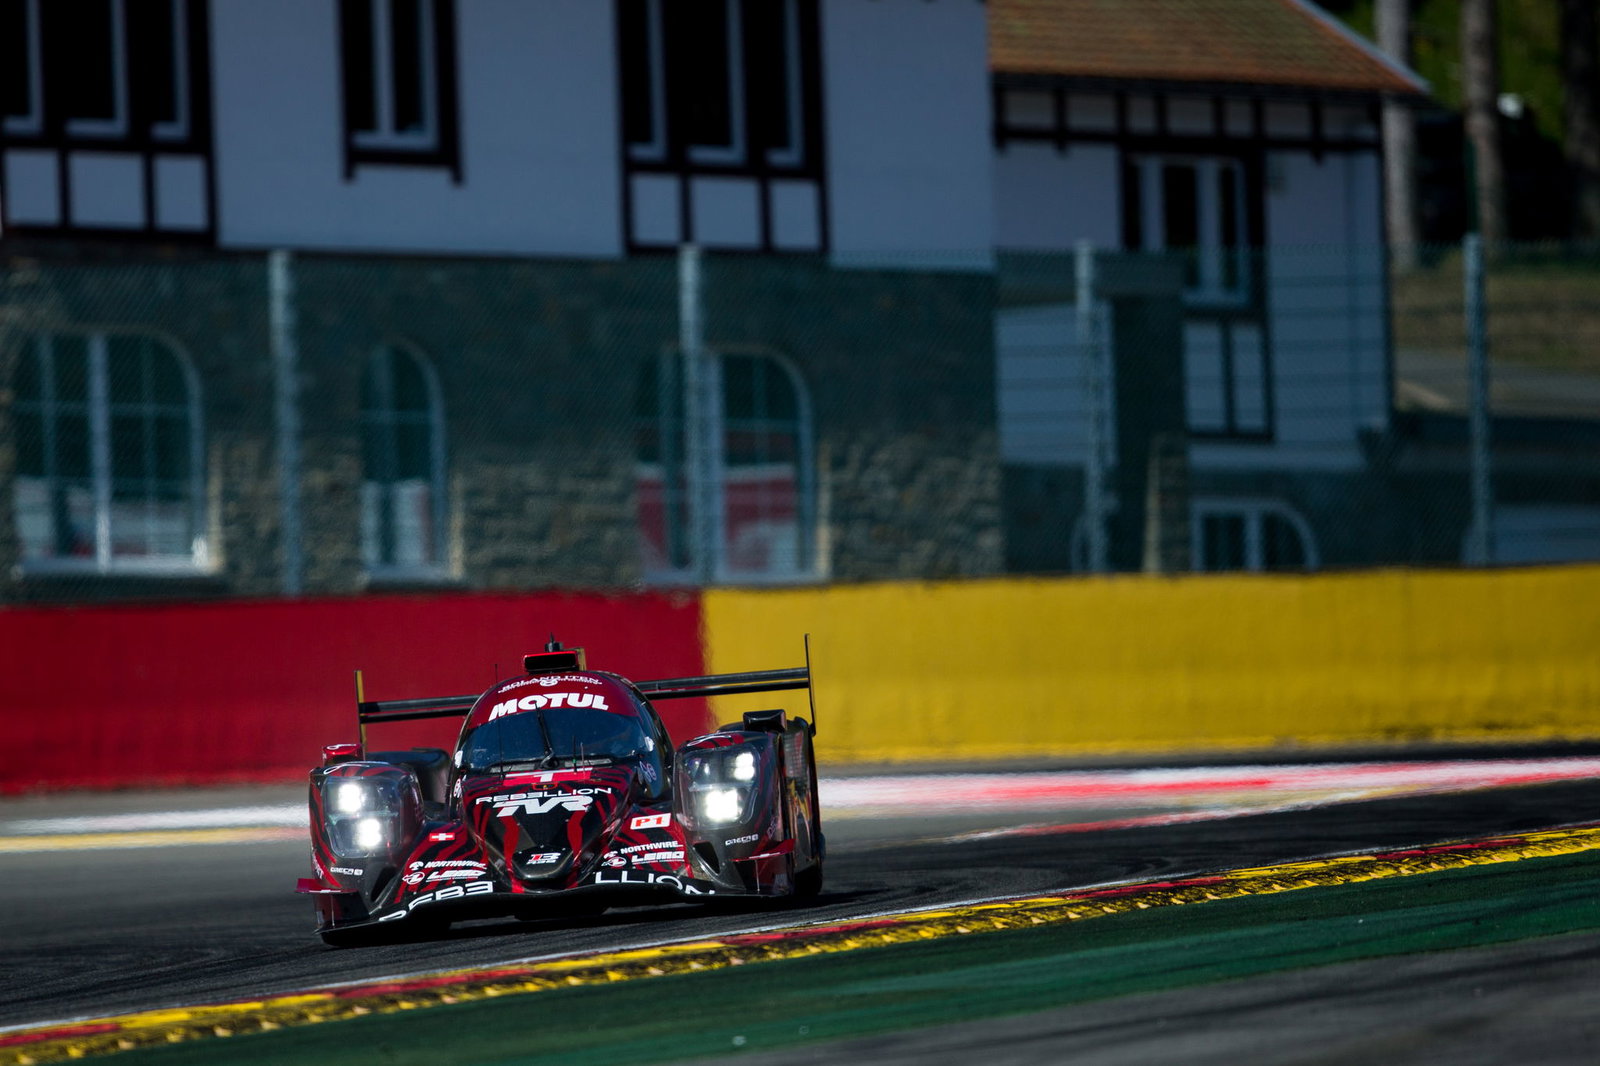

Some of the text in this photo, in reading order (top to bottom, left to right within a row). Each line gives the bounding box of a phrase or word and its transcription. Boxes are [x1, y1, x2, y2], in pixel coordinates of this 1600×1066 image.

[488, 693, 609, 721] MOTUL
[475, 788, 612, 805] REBELLION
[492, 795, 594, 817] TVR
[635, 817, 663, 827] P1
[620, 841, 684, 854] NORTHWIRE
[631, 851, 685, 863] LEMO
[424, 860, 487, 870] NORTHWIRE
